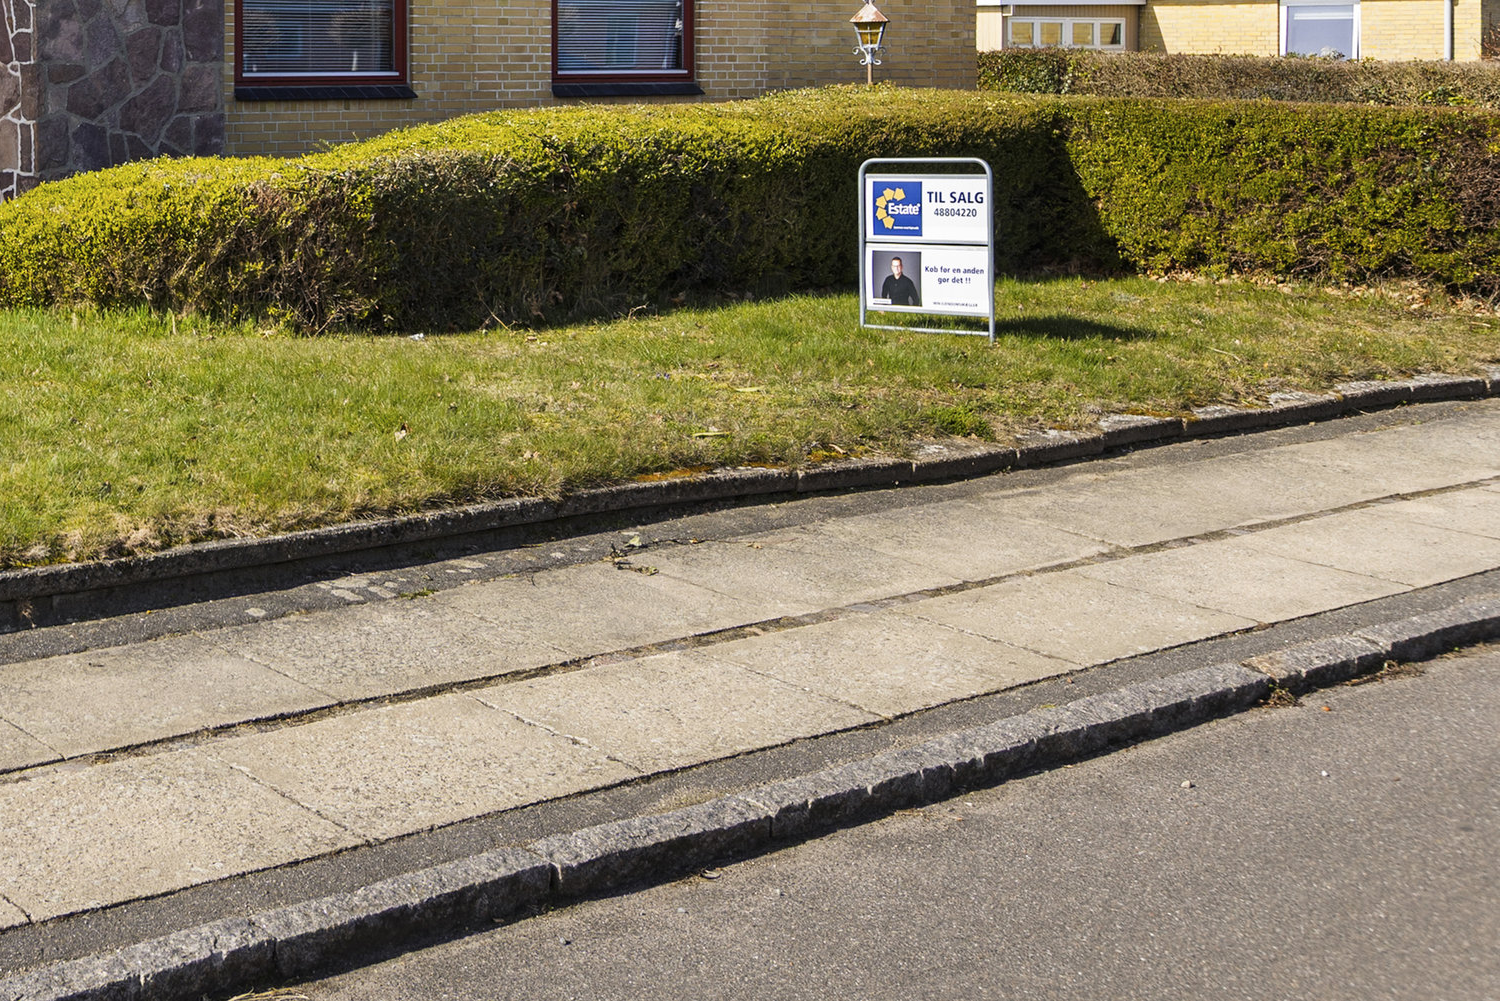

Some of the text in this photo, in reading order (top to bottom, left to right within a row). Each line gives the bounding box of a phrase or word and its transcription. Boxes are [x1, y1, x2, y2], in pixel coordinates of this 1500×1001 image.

[927, 191, 984, 204] TIL SALG
[888, 202, 920, 215] Estate
[934, 208, 977, 217] 48804220
[963, 266, 984, 274] anden
[951, 276, 964, 284] det
